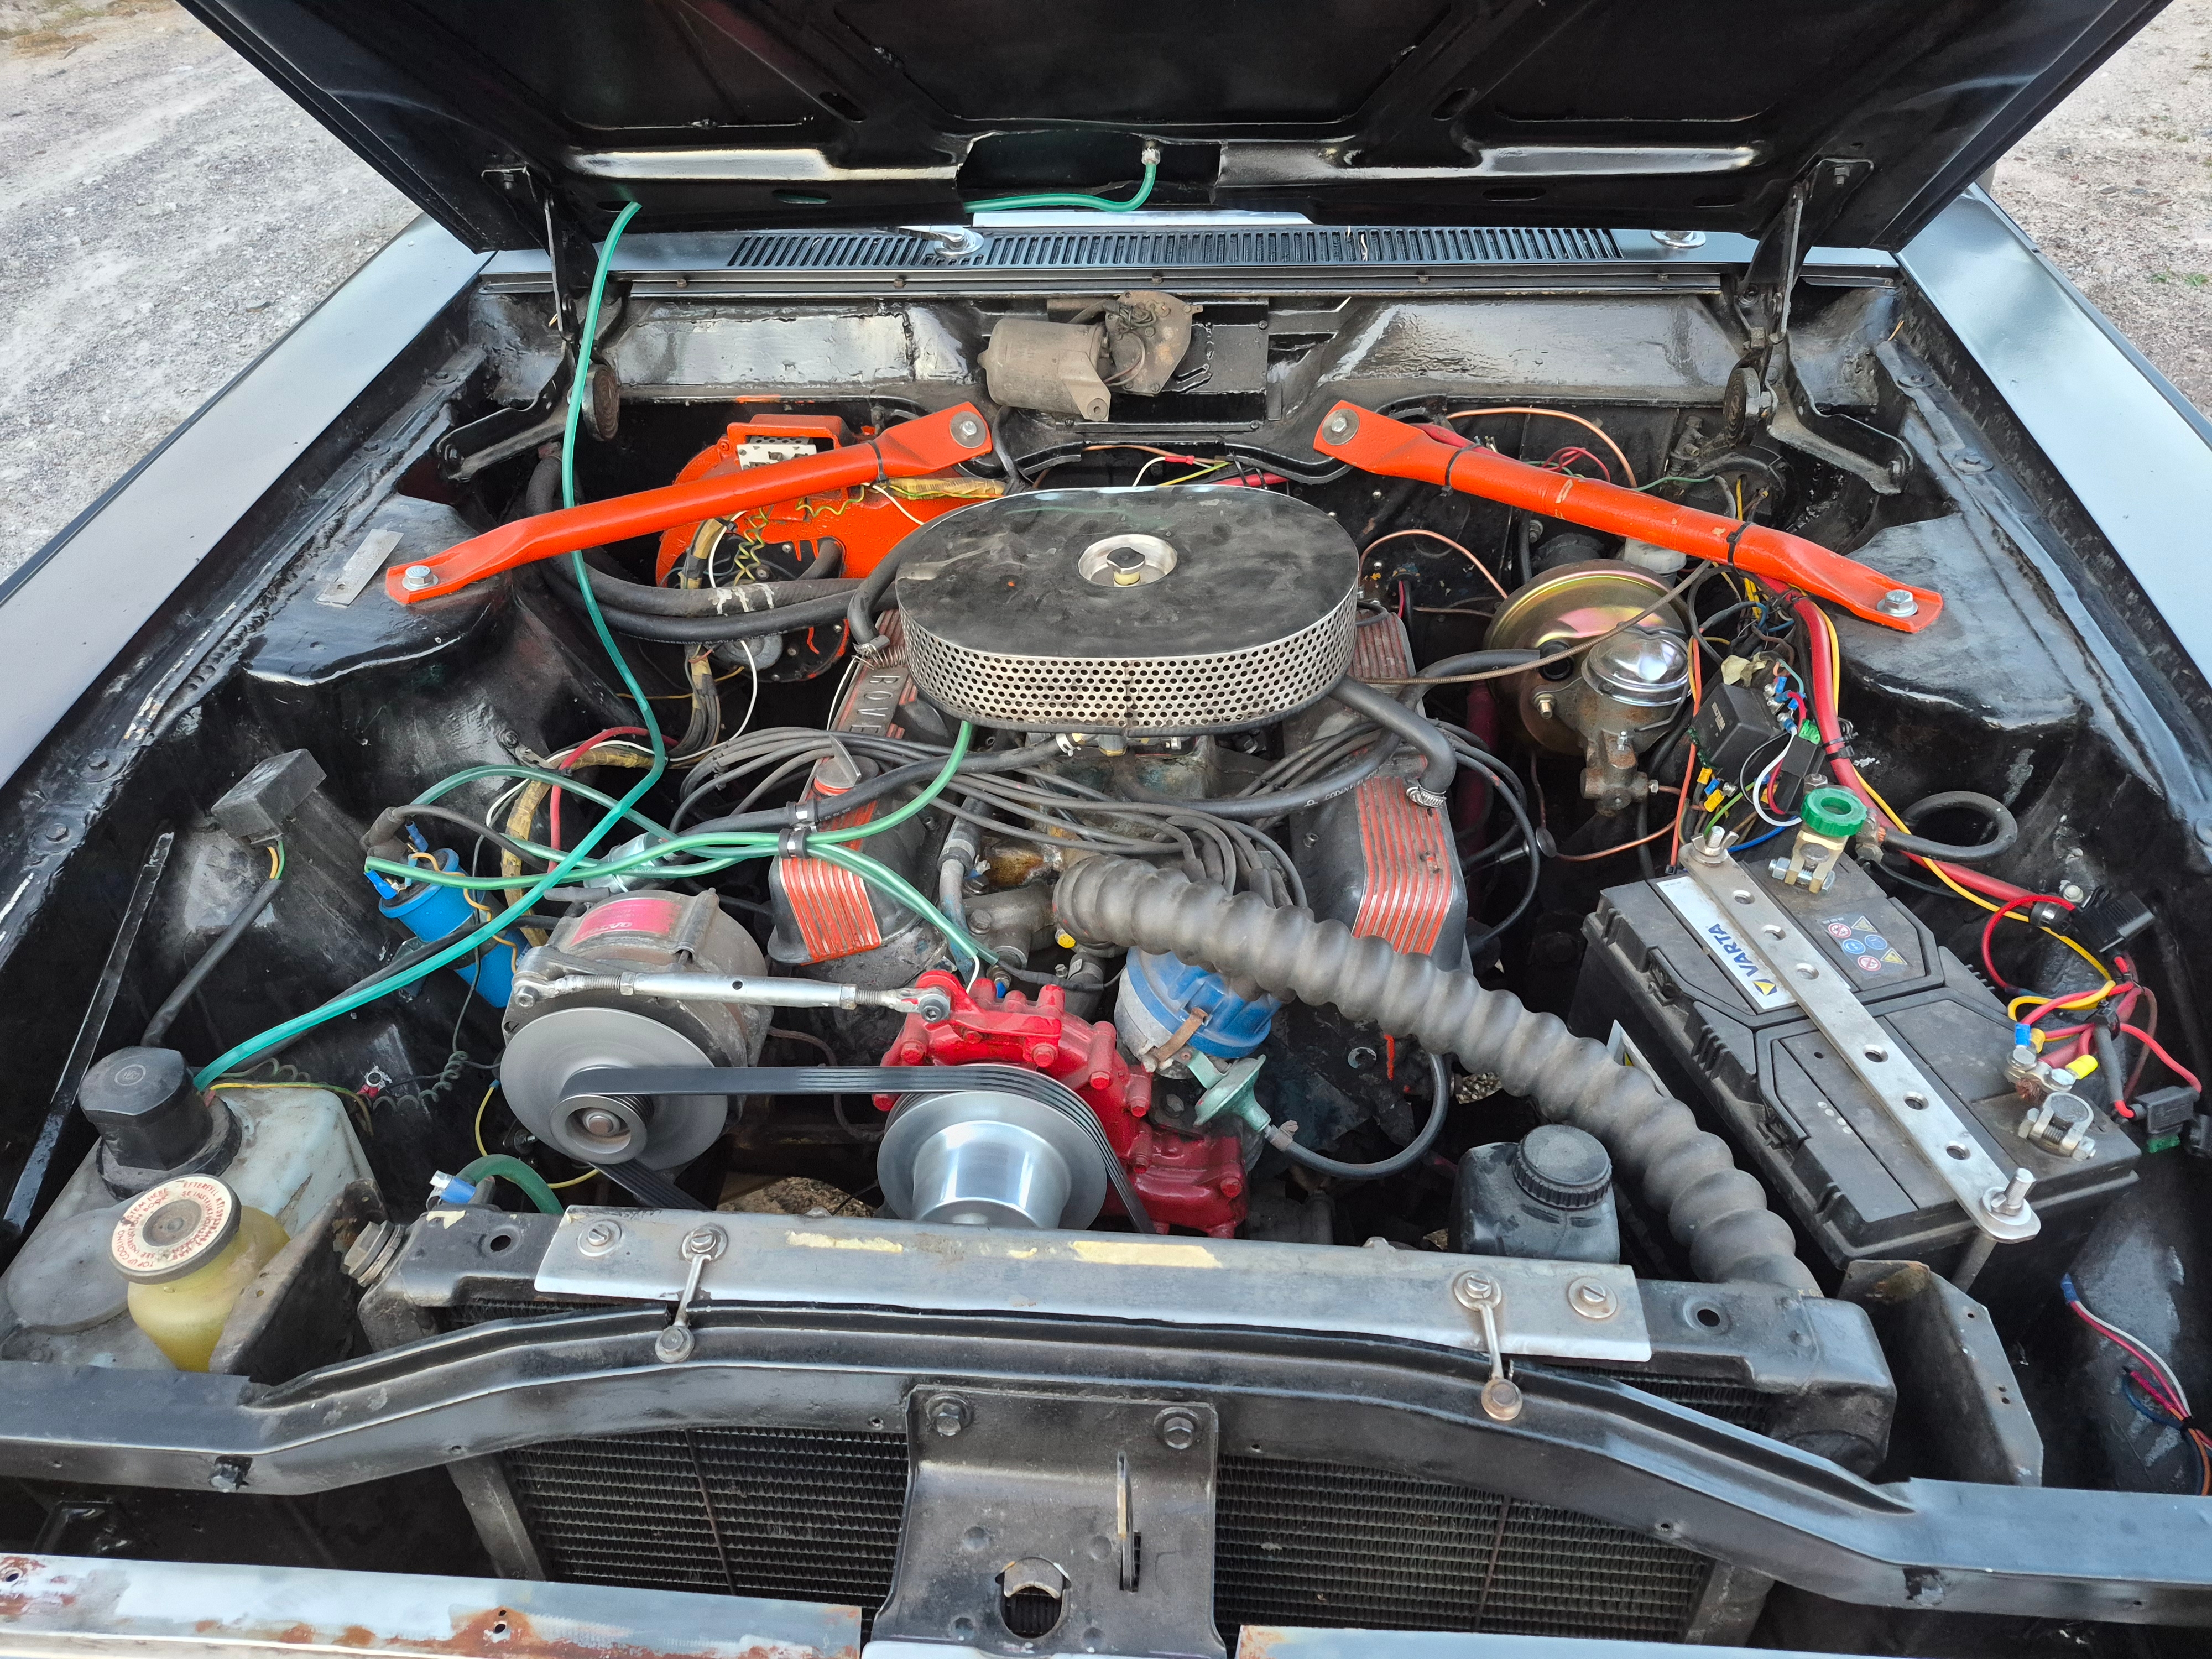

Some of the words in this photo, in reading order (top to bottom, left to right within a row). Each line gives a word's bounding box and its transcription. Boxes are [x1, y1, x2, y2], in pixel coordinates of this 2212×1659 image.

[849, 675, 900, 734] ROVE
[1708, 923, 1759, 977] VARTA
[183, 1182, 219, 1197] EFTERFYLL
[117, 1229, 131, 1260] COOLING
[147, 1188, 168, 1202] HERE
